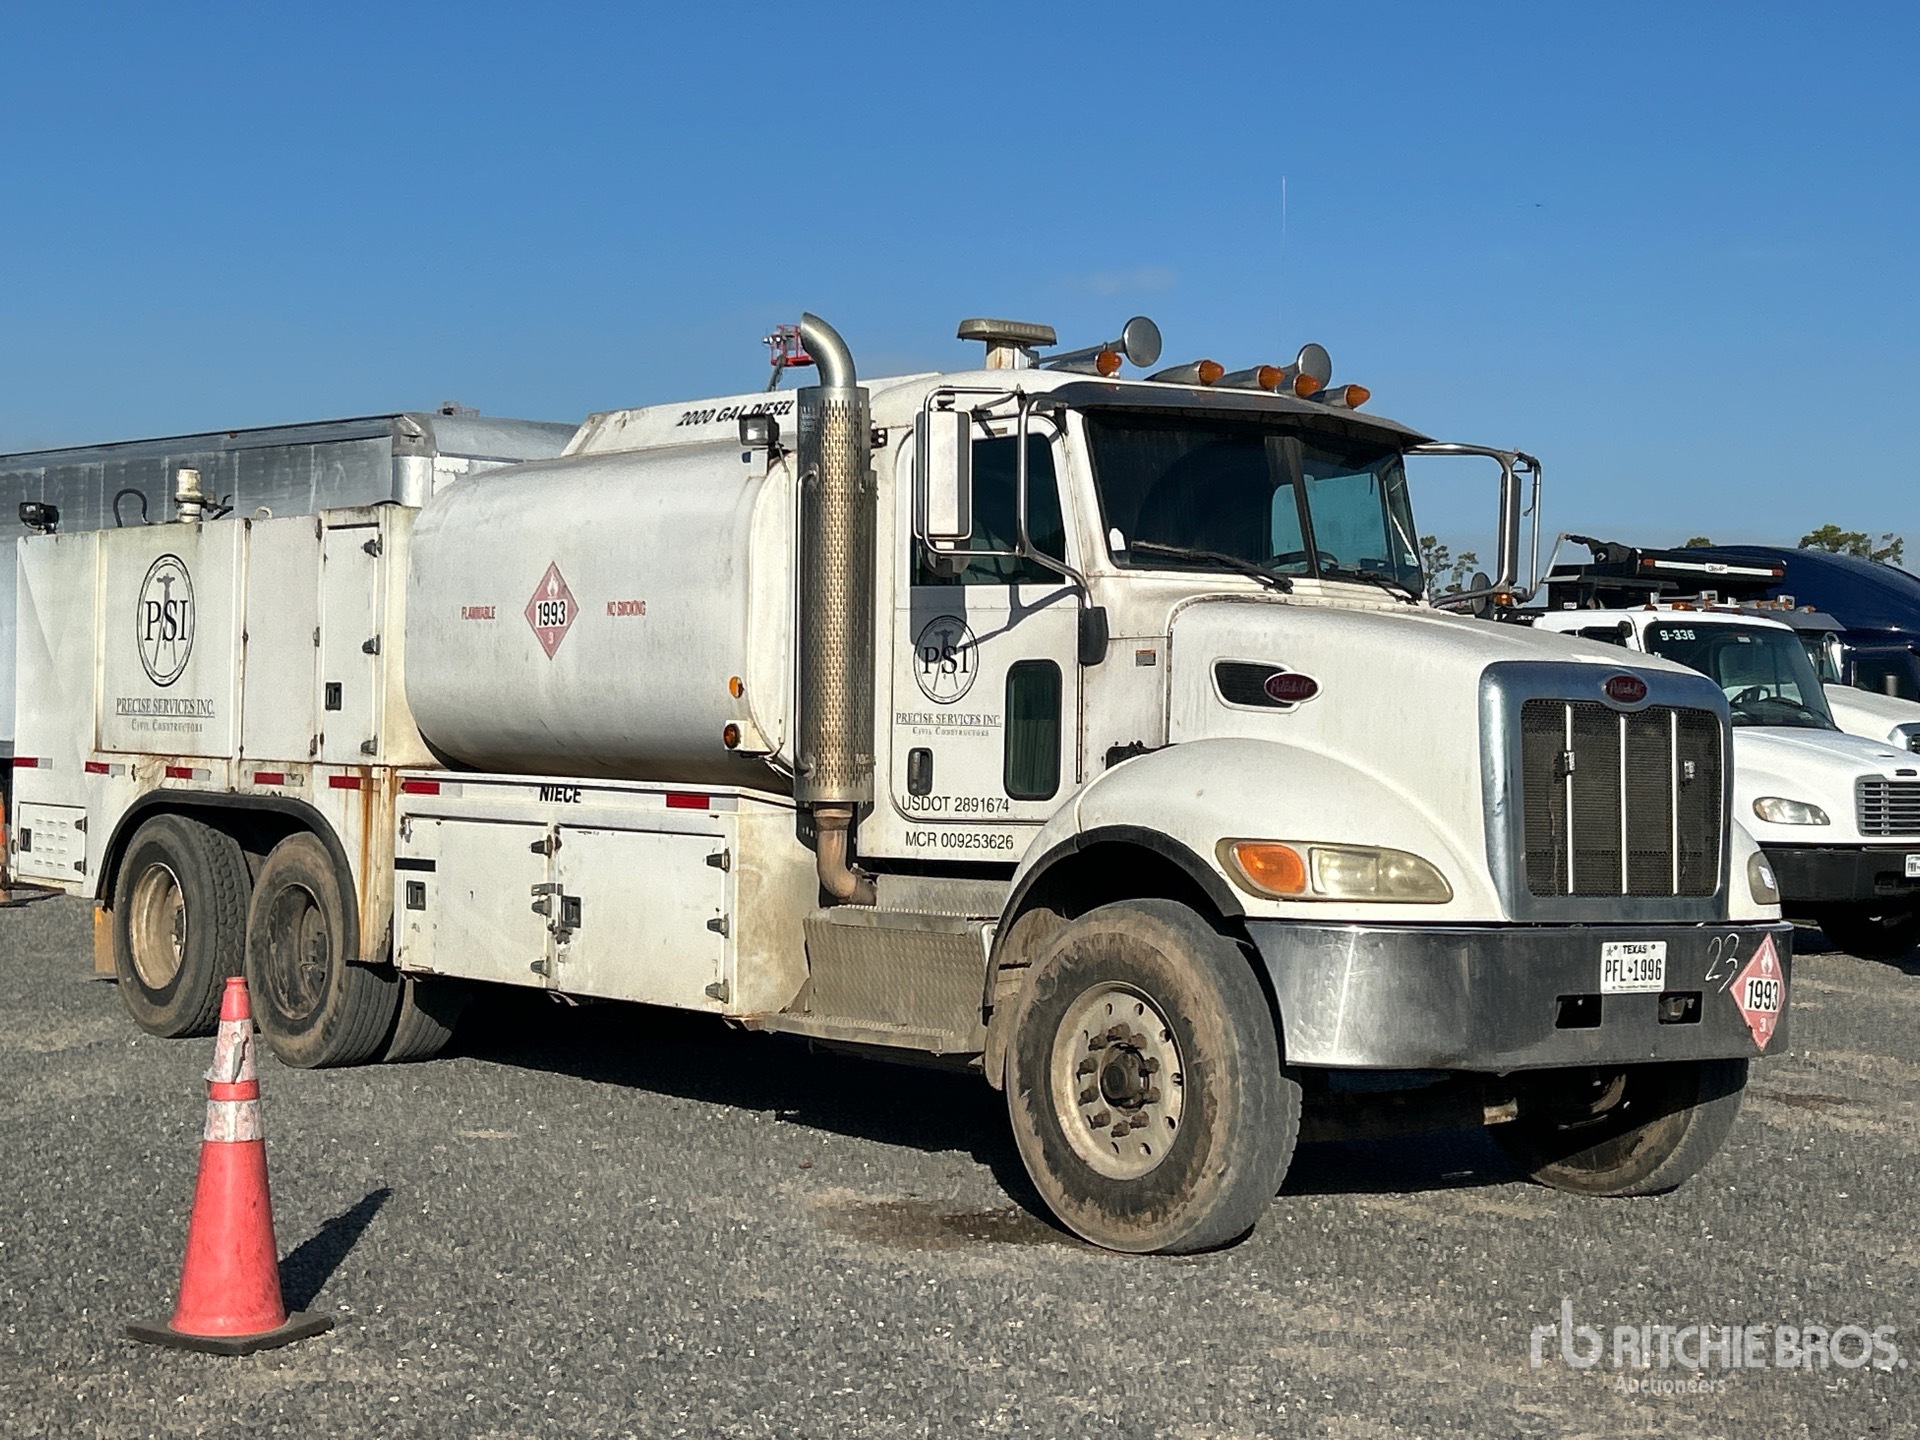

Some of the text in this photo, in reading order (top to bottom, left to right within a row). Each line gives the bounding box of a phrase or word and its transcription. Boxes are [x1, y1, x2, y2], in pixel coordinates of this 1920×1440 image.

[676, 408, 716, 426] 2000
[144, 600, 188, 642] PSI
[537, 601, 566, 626] 1993
[549, 631, 554, 645] 3
[1660, 630, 1696, 641] 9-336
[922, 646, 970, 674] PSI
[116, 697, 151, 713] PRECISE
[152, 698, 195, 715] SERVICES
[896, 712, 934, 724] PRECISE
[935, 714, 982, 726] SERVICES
[539, 786, 582, 804] NIECE
[902, 795, 1010, 813] USDOT 2891674
[905, 831, 1014, 850] MCR 009253626
[1622, 944, 1648, 955] TEXAS
[1748, 979, 1777, 1011] 1993
[1759, 1017, 1767, 1033] 3
